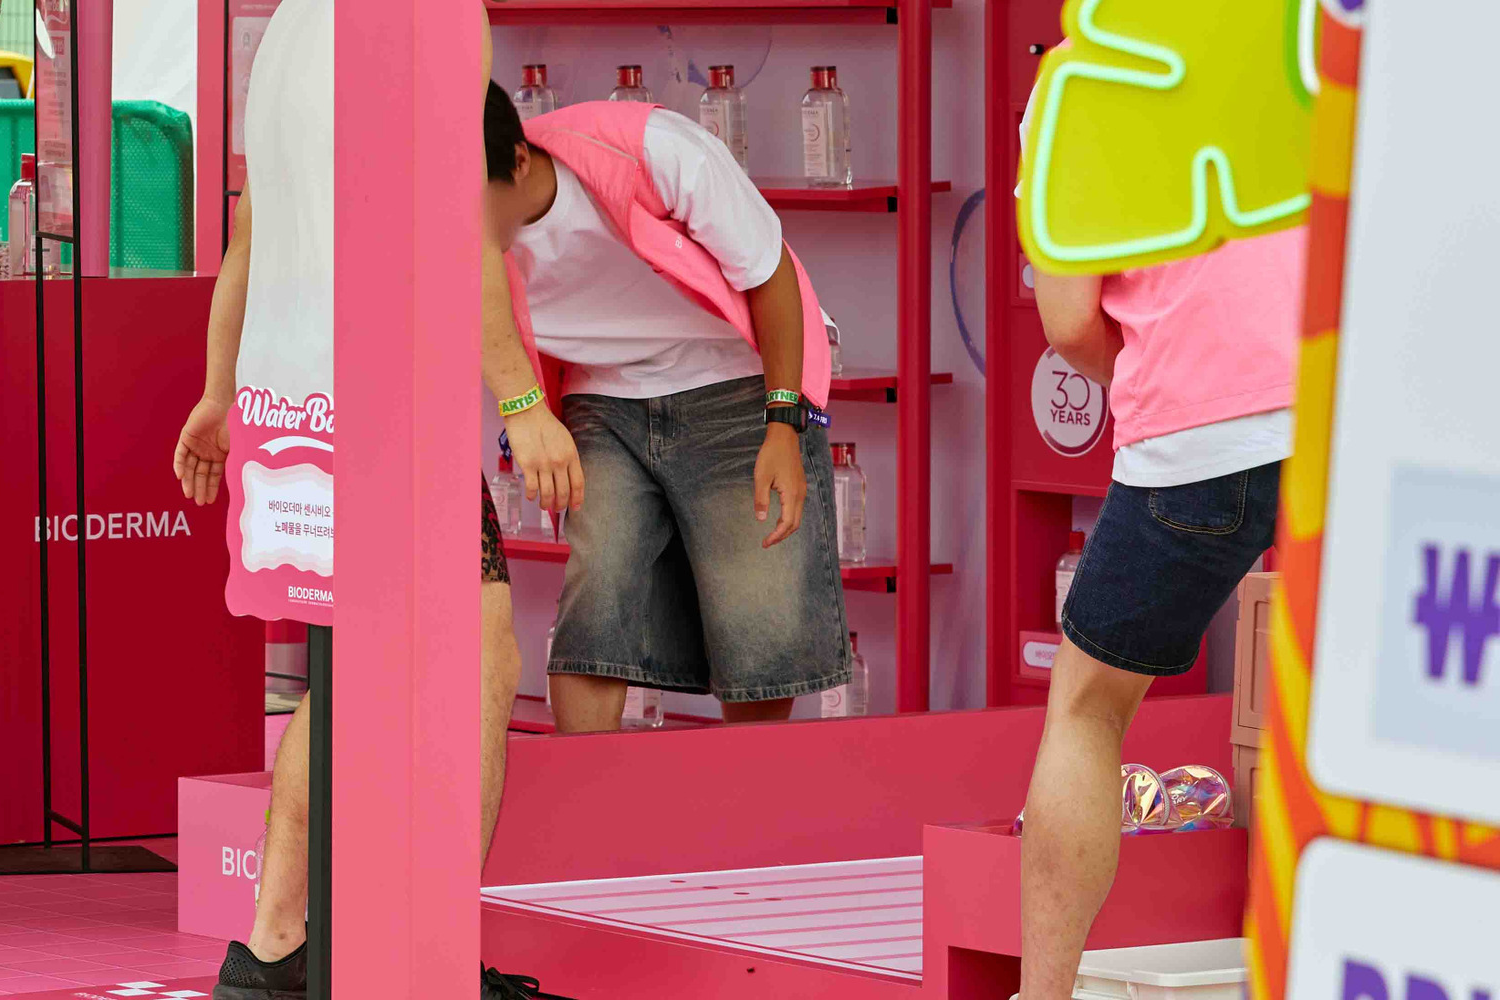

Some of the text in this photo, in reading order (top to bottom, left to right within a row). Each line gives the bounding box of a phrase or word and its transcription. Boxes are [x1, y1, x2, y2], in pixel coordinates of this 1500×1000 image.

[502, 389, 538, 412] ARTIST
[1051, 370, 1090, 411] 30
[237, 390, 307, 430] Water
[1050, 409, 1091, 426] YEARS
[268, 500, 331, 518] 바이오더마 센시비오
[34, 511, 191, 543] BIODERMA
[275, 521, 301, 535] 노폐물을
[288, 585, 334, 602] BIODERMA
